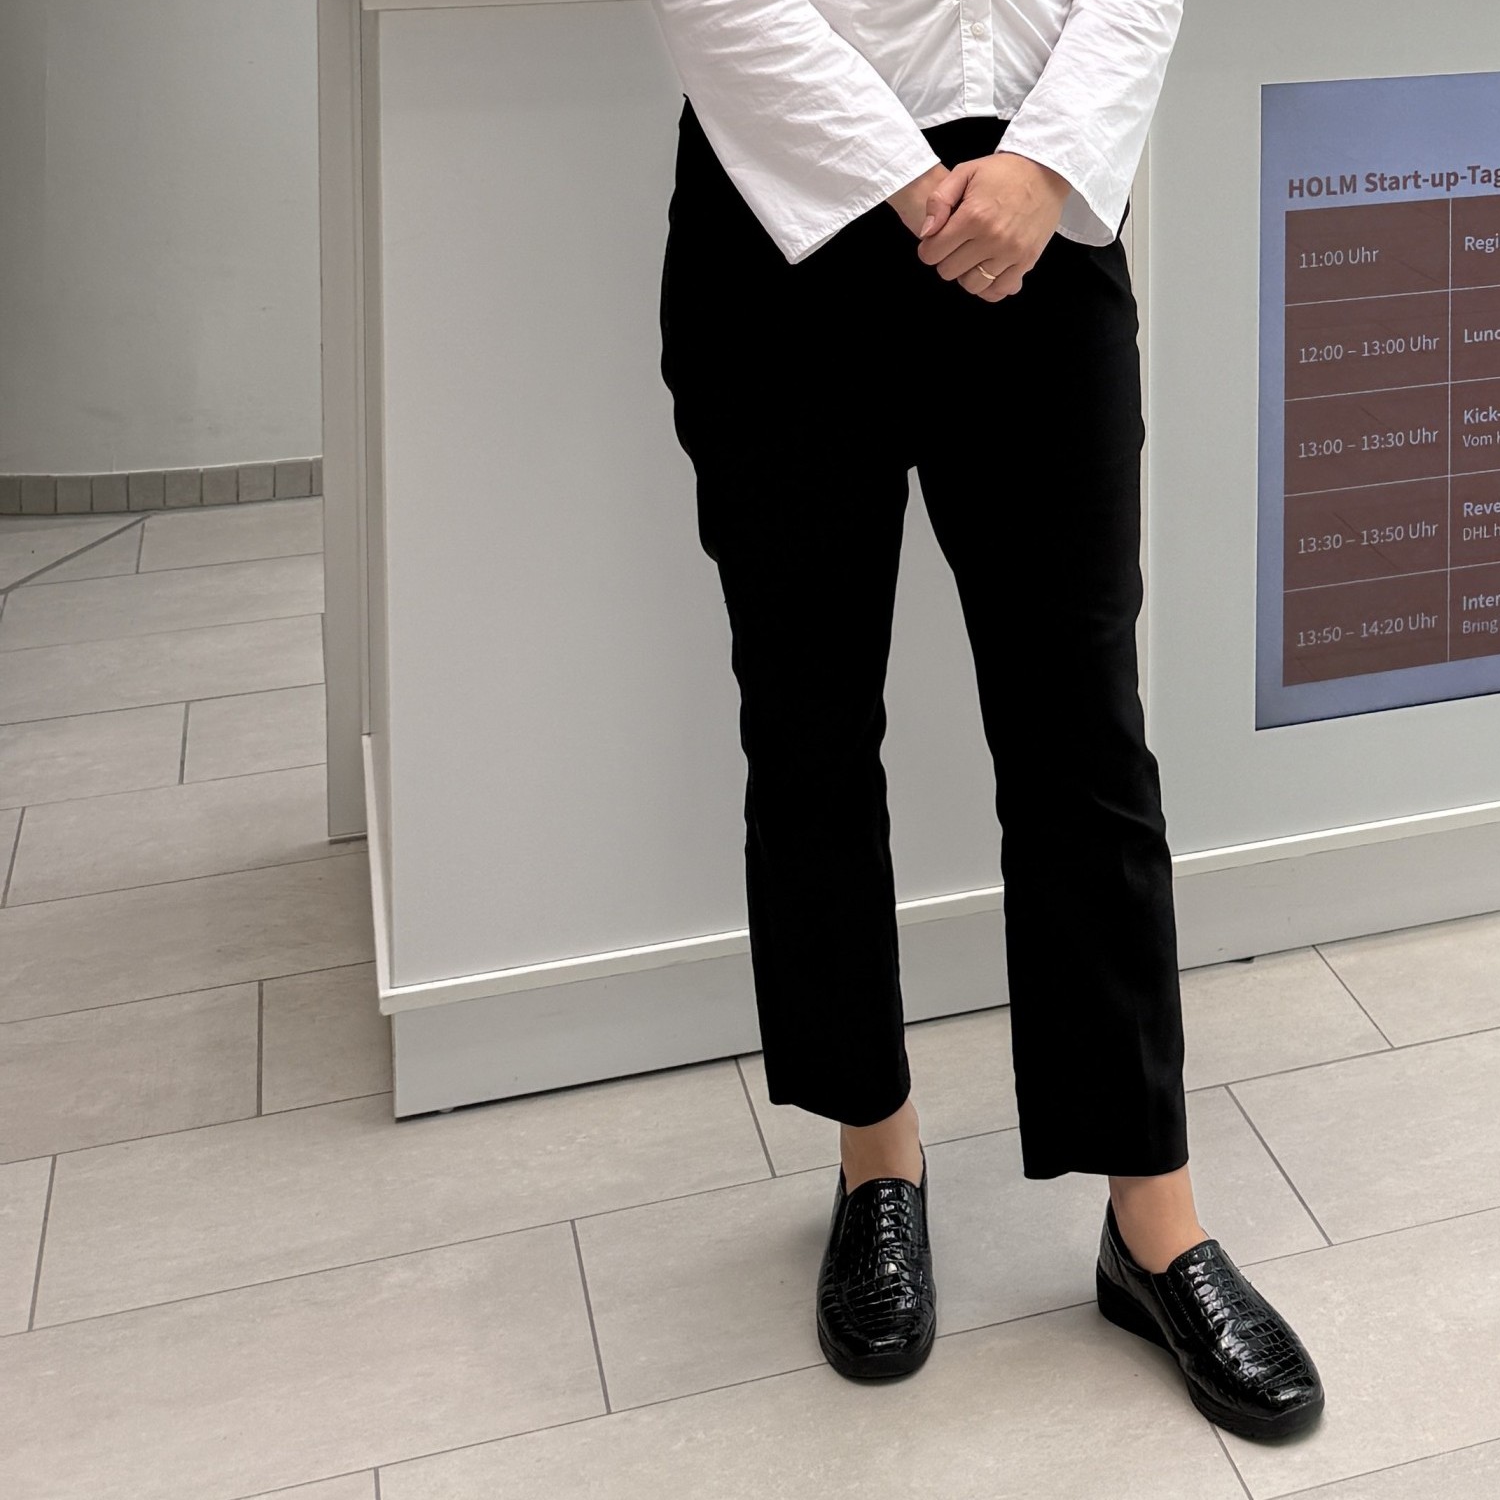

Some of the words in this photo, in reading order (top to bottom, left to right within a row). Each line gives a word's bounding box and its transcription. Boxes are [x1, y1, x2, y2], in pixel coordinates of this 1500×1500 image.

[1288, 173, 1358, 199] HOLM
[1298, 250, 1344, 270] 11:00
[1347, 246, 1380, 265] Uhr
[1298, 344, 1344, 364] 12:00
[1361, 338, 1406, 358] 13:00
[1408, 334, 1440, 353] Uhr
[1298, 438, 1344, 459] 13:00
[1360, 432, 1406, 452] 13:30
[1408, 427, 1440, 446] Uhr
[1462, 432, 1494, 449] Vom
[1297, 532, 1343, 555] 13:30
[1360, 526, 1405, 547] 13:50
[1408, 520, 1439, 541] Uhr
[1462, 524, 1492, 542] DHL
[1296, 625, 1343, 648] 13:50
[1359, 618, 1405, 639] 14:20
[1407, 611, 1439, 632] Uhr
[1462, 617, 1499, 636] Bring
